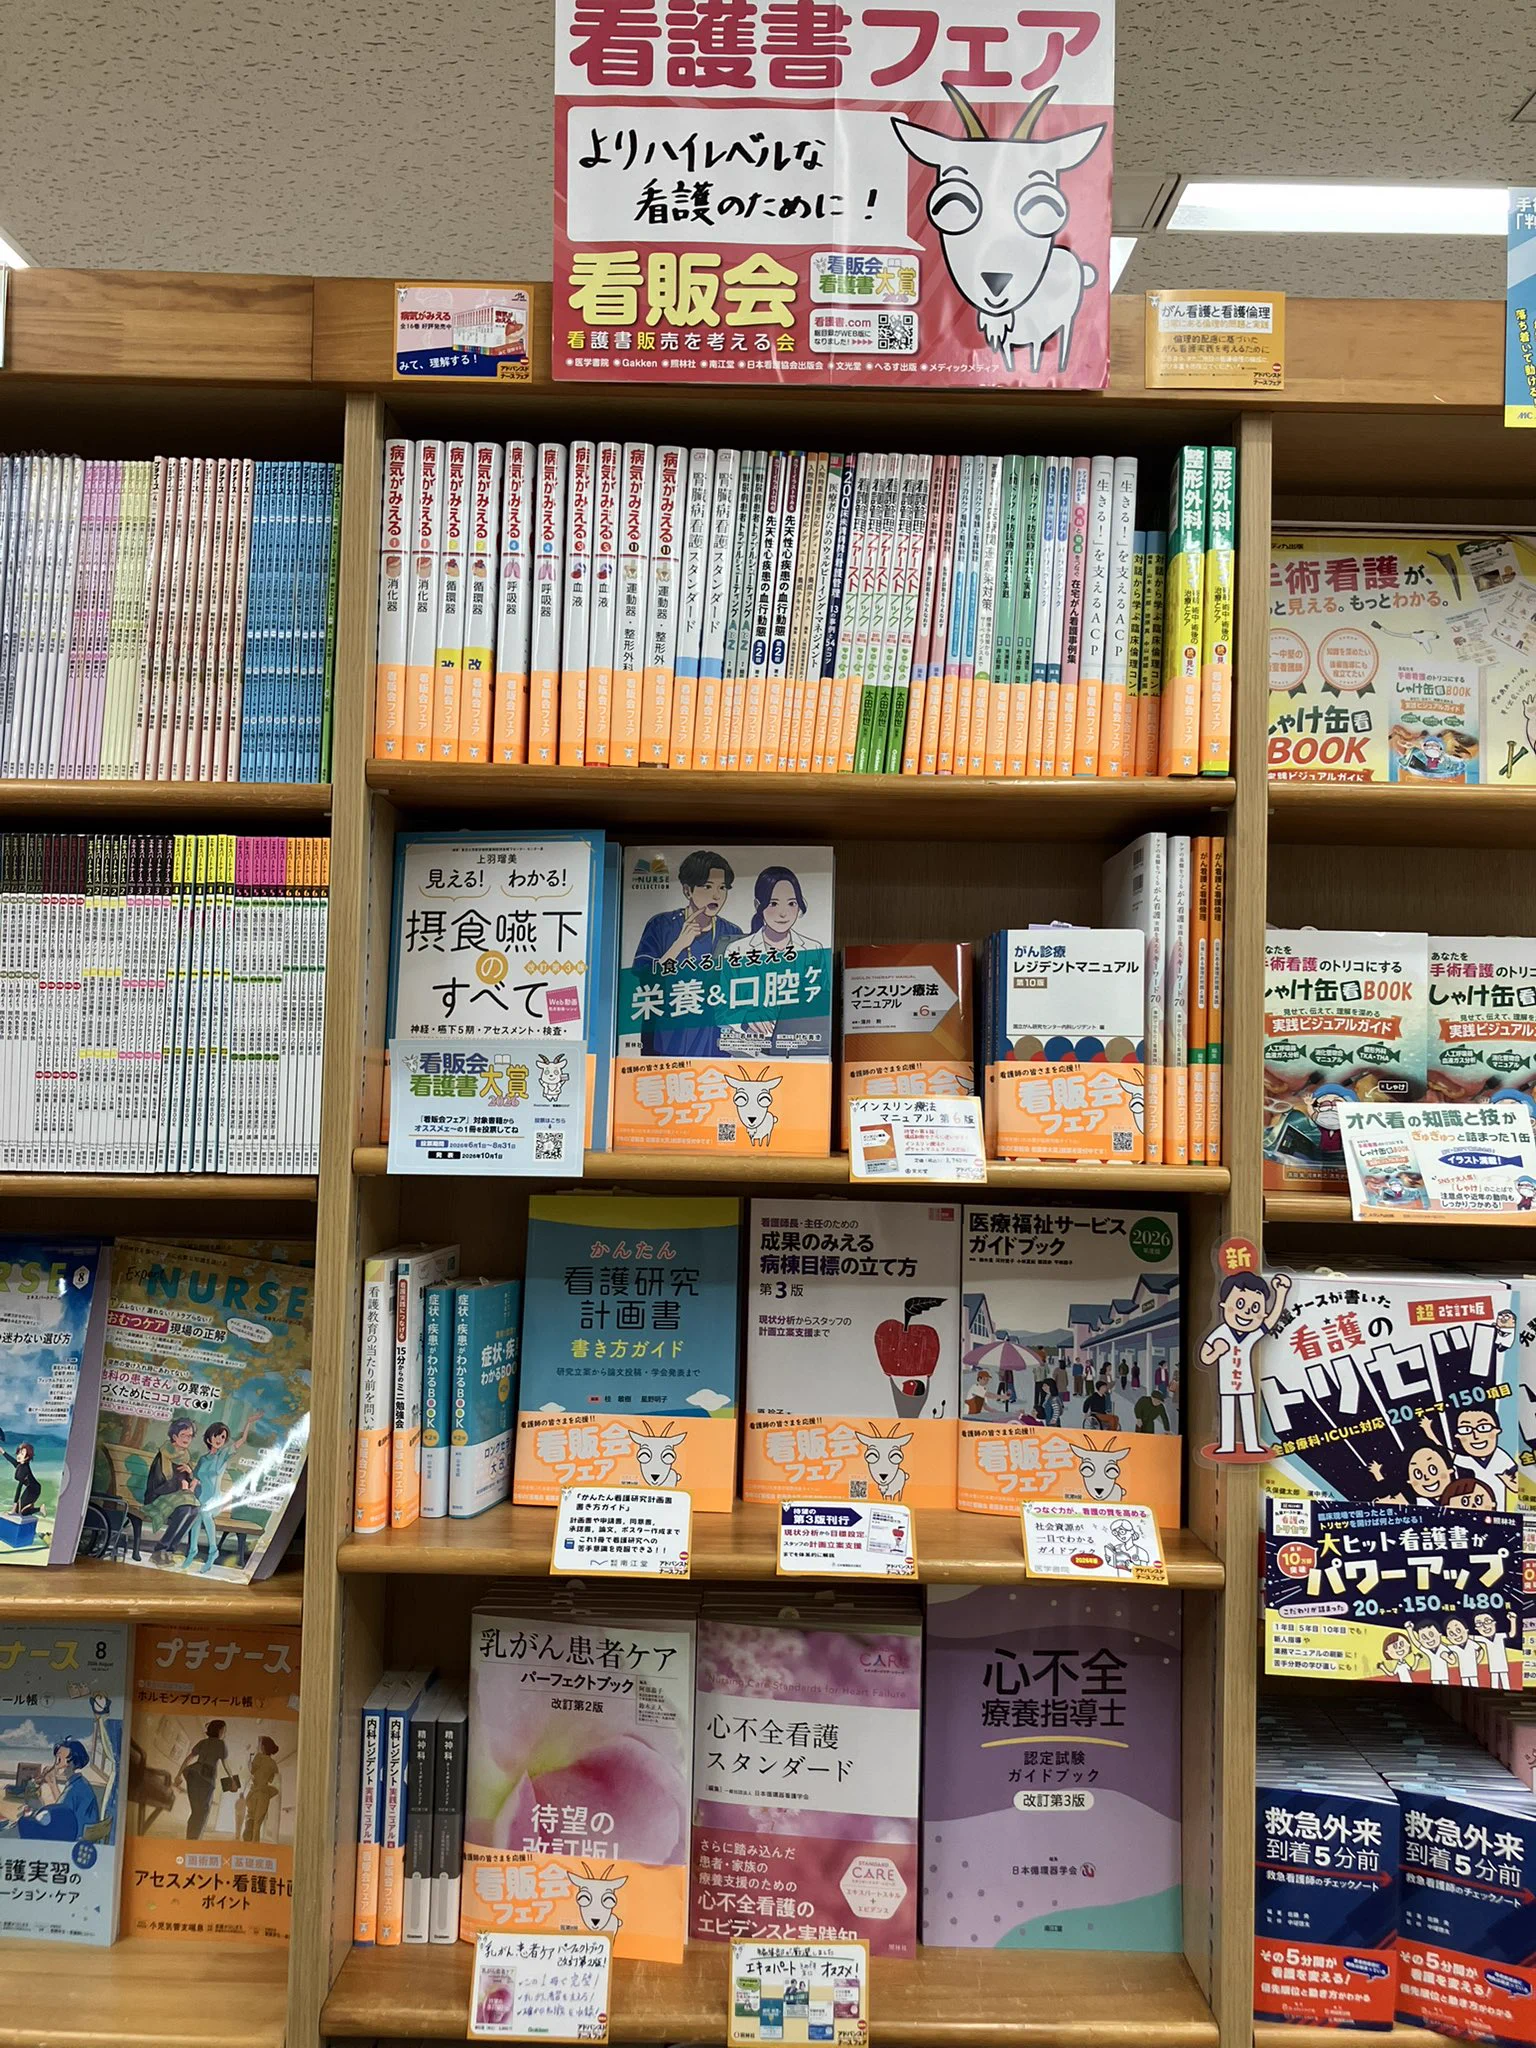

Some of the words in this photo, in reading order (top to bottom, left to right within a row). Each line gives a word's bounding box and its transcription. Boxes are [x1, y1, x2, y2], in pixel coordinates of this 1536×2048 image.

[570, 0, 1101, 90] 看護書フェア
[578, 129, 826, 171] よりハイレベルな
[634, 179, 879, 225] 看護のために!
[828, 256, 882, 275] 看販会
[569, 251, 798, 327] 看販会
[819, 275, 874, 295] 看護書
[876, 267, 916, 297] 大賞
[400, 311, 451, 321] 病気がみえる
[814, 317, 871, 328] 看護書.com
[1162, 305, 1270, 319] がん看護と看護倫理
[567, 331, 795, 352] 看護書販売を考える会
[1162, 345, 1270, 354] がん看護実践を考えるために
[1173, 335, 1258, 343] 倫理的配慮に基づいた
[575, 358, 609, 367] 医学書院
[622, 359, 657, 368] Gakken
[670, 360, 696, 368] 照林社
[709, 360, 735, 369] 南江堂
[836, 362, 861, 371] 文光堂
[875, 363, 917, 371] へるす出版
[930, 364, 999, 372] メディックメディア
[387, 445, 405, 536] 病気がみえる
[418, 446, 437, 537] 病気がみえる
[446, 447, 465, 538] 病気がみえる
[476, 448, 493, 539] 病気がみえる
[507, 447, 524, 539] 病気がみえる
[541, 450, 559, 541] 病気がみえる
[573, 447, 591, 539] 病気がみえる
[600, 448, 618, 540] 病気がみえる
[627, 450, 647, 544] 病気がみえる
[659, 452, 680, 544] 病気がみえる
[685, 471, 708, 634] 腎臓病看護スタンダード
[1090, 471, 1111, 657] 「生きる!」を支えるACP
[755, 515, 778, 637] 先天性心疾患の血行動態
[774, 515, 797, 637] 先天性心疾患の血行動態
[1114, 472, 1135, 658] 「生きる!」を支えるACP
[387, 579, 399, 613] 消化器
[417, 580, 429, 613] 消化器
[445, 581, 457, 615] 循環器
[472, 581, 484, 616] 循環器
[506, 581, 518, 615] 呼吸器
[540, 584, 552, 617] 呼吸器
[571, 583, 583, 607] 血液
[598, 583, 609, 608] 血液
[1067, 579, 1082, 664] 在宅がん看護事例集
[477, 854, 517, 864] 上羽瑠美
[425, 869, 484, 889] 見える!
[508, 869, 566, 888] わかる!
[1199, 853, 1207, 922] がん看護と看護倫理
[406, 909, 582, 952] 摂食嚥下
[650, 945, 798, 976] 「食べる」を支える
[1014, 945, 1066, 958] がん診療
[1431, 952, 1468, 962] あなたを
[480, 957, 504, 978] の
[1013, 960, 1139, 974] レジデントマニュアル
[852, 984, 939, 997] インスリン療法
[1016, 979, 1045, 988] 第10版
[432, 976, 548, 1018] すべて
[851, 999, 902, 1009] マニュアル
[1272, 1017, 1392, 1034] 実践ビジュアルガイド
[420, 1052, 488, 1074] 看販会
[621, 1061, 692, 1074] 看護師の皆さまを応援!!
[999, 1064, 1081, 1078] 看護師の皆さまを応援!!
[410, 1075, 478, 1097] 看護書
[480, 1064, 529, 1099] 大賞
[636, 1068, 728, 1105] 看販会
[1019, 1073, 1122, 1113] 看販会
[488, 1096, 520, 1107] 2026
[860, 1102, 936, 1112] インスリン療法
[655, 1104, 712, 1126] フェア
[880, 1114, 934, 1123] マニュアル
[1040, 1110, 1104, 1134] フェア
[1346, 1109, 1517, 1130] オペ看の知識と技が
[1412, 1131, 1531, 1143] ぎゅぎゅっと詰まった1缶
[761, 1218, 858, 1230] 看護師長・主任のための
[969, 1212, 1126, 1236] 医療福祉サービス
[590, 1240, 676, 1260] かんたん
[760, 1232, 874, 1252] 成果のみえる
[969, 1237, 1066, 1257] ガイドブック
[1132, 1229, 1170, 1247] 2026
[760, 1254, 918, 1278] 病棟目標の立て方
[1225, 1247, 1251, 1269] 新
[77, 1271, 85, 1284] 8
[564, 1266, 700, 1297] 看護研究
[147, 1263, 310, 1319] NURSE
[759, 1281, 804, 1299] 第3版
[108, 1312, 166, 1332] おむつケア
[170, 1323, 226, 1341] 現場の正解
[581, 1300, 681, 1330] 計画書
[758, 1315, 852, 1326] 現状分析からスタッフの
[758, 1327, 830, 1338] 計画立案支援まで
[1290, 1312, 1393, 1361] 看護の
[571, 1338, 684, 1359] 書き方ガイド
[427, 1294, 440, 1428] 症状・疾患がわかるBOOK
[456, 1294, 469, 1428] 症状・疾患がわかるBOOK
[556, 1368, 700, 1378] 研究立案から論文投稿・学会発表まで
[1231, 1346, 1242, 1391] トリセツ
[395, 1347, 406, 1429] 15分からのミニ勉強会
[1261, 1323, 1496, 1433] トリセツ
[520, 1415, 596, 1429] 看護師の皆さまを応援!!
[750, 1417, 823, 1430] 看護師の皆さまを応援!!
[537, 1423, 632, 1463] 看販会
[555, 1458, 614, 1484] フェア
[784, 1460, 843, 1483] フェア
[998, 1470, 1057, 1494] フェア
[576, 1504, 630, 1512] 書き方ガイド」
[577, 1494, 672, 1504] 「かんたん看護研究計画書
[794, 1515, 849, 1525] 第3版刊行
[1034, 1507, 1147, 1518] つなぐ力が、看護の質を高める
[1492, 1518, 1516, 1526] 照林社
[1035, 1523, 1084, 1531] 社会資源が
[1037, 1535, 1095, 1543] 一目でわかる
[579, 1536, 658, 1544] これ1冊で看護研究への
[1317, 1526, 1487, 1558] 大ヒット看護書が
[1307, 1548, 1509, 1596] パワーアップ
[1283, 1605, 1344, 1616] こだわりが詰まった
[479, 1628, 678, 1671] 乳がん患者ケア
[1273, 1636, 1302, 1644] 新人指導
[155, 1638, 291, 1674] プチナース
[521, 1673, 634, 1694] パーフェクトブック
[982, 1648, 1128, 1697] 心不全
[138, 1690, 253, 1708] ホルモンプロフィール帳
[747, 1679, 769, 1689] Care
[773, 1681, 821, 1694] Standards
[824, 1684, 839, 1694] for
[842, 1687, 868, 1697] Heart
[872, 1688, 907, 1699] Failure
[551, 1698, 604, 1713] 改訂第2版
[981, 1699, 1126, 1727] 療養指導士
[707, 1712, 840, 1750] 心不全看護
[365, 1719, 377, 1785] 内科レジデント
[389, 1720, 401, 1786] 内科レジデント
[417, 1730, 426, 1760] 精神科
[445, 1731, 453, 1761] 精神科
[706, 1751, 854, 1783] スタンダード
[1023, 1751, 1086, 1766] 認定試験
[1008, 1768, 1099, 1783] ガイドブック
[364, 1787, 373, 1838] 実践マニュアル
[1023, 1793, 1085, 1809] 改訂第3版
[387, 1788, 396, 1840] 実践マニュアル
[531, 1803, 615, 1836] 待望の
[1264, 1807, 1382, 1847] 救急外来
[1404, 1809, 1524, 1862] 救急外来
[700, 1838, 796, 1860] さらに踏み込んだ
[1266, 1838, 1379, 1872] 到着5分前
[699, 1854, 768, 1873] 患者・家族の
[852, 1867, 895, 1881] CARE
[1012, 1865, 1077, 1876] 日本循環器学会
[1406, 1840, 1522, 1888] 到着5分前
[698, 1874, 797, 1892] 療養支援のための
[1266, 1869, 1379, 1893] 救急看護師のチェックノート
[1406, 1872, 1521, 1909] 救急看護師のチェックノート
[202, 1894, 250, 1911] ポイント
[492, 1901, 554, 1924] フェア
[698, 1890, 815, 1918] 心不全看護の
[857, 1906, 889, 1914] エビデンス
[485, 1941, 555, 1960] 乳がん患者ケア
[1260, 1948, 1337, 1969] その5分間が
[746, 1961, 796, 1975] エキスパート
[822, 1963, 858, 1978] オススメ!
[1400, 1951, 1479, 1979] その5分間が
[1261, 1982, 1371, 2003] 優先順位と動き方がわかる
[1400, 1983, 1513, 2020] 優先順位と動き方がわかる
